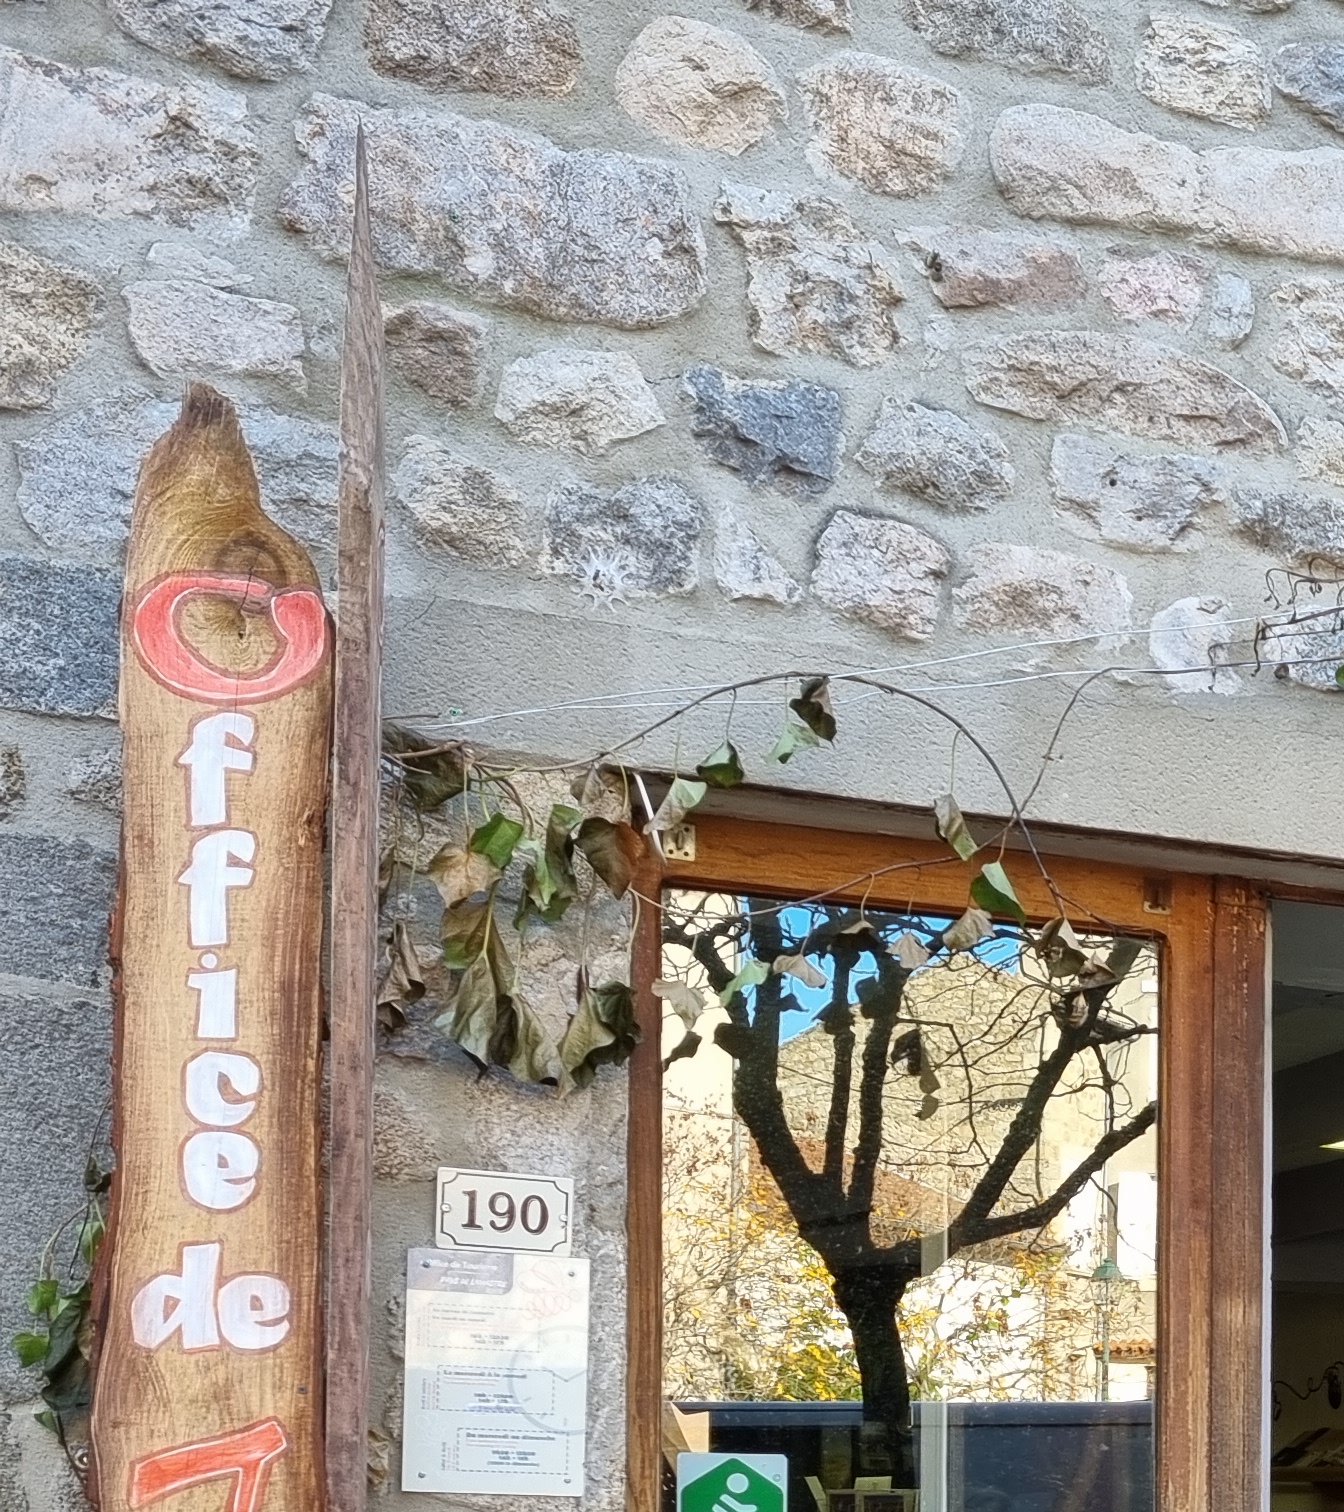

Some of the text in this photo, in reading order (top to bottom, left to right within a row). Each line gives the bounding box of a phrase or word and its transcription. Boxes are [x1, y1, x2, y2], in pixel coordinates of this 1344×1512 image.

[131, 569, 330, 1212] Office
[460, 1188, 550, 1235] 190
[129, 1240, 293, 1354] de
